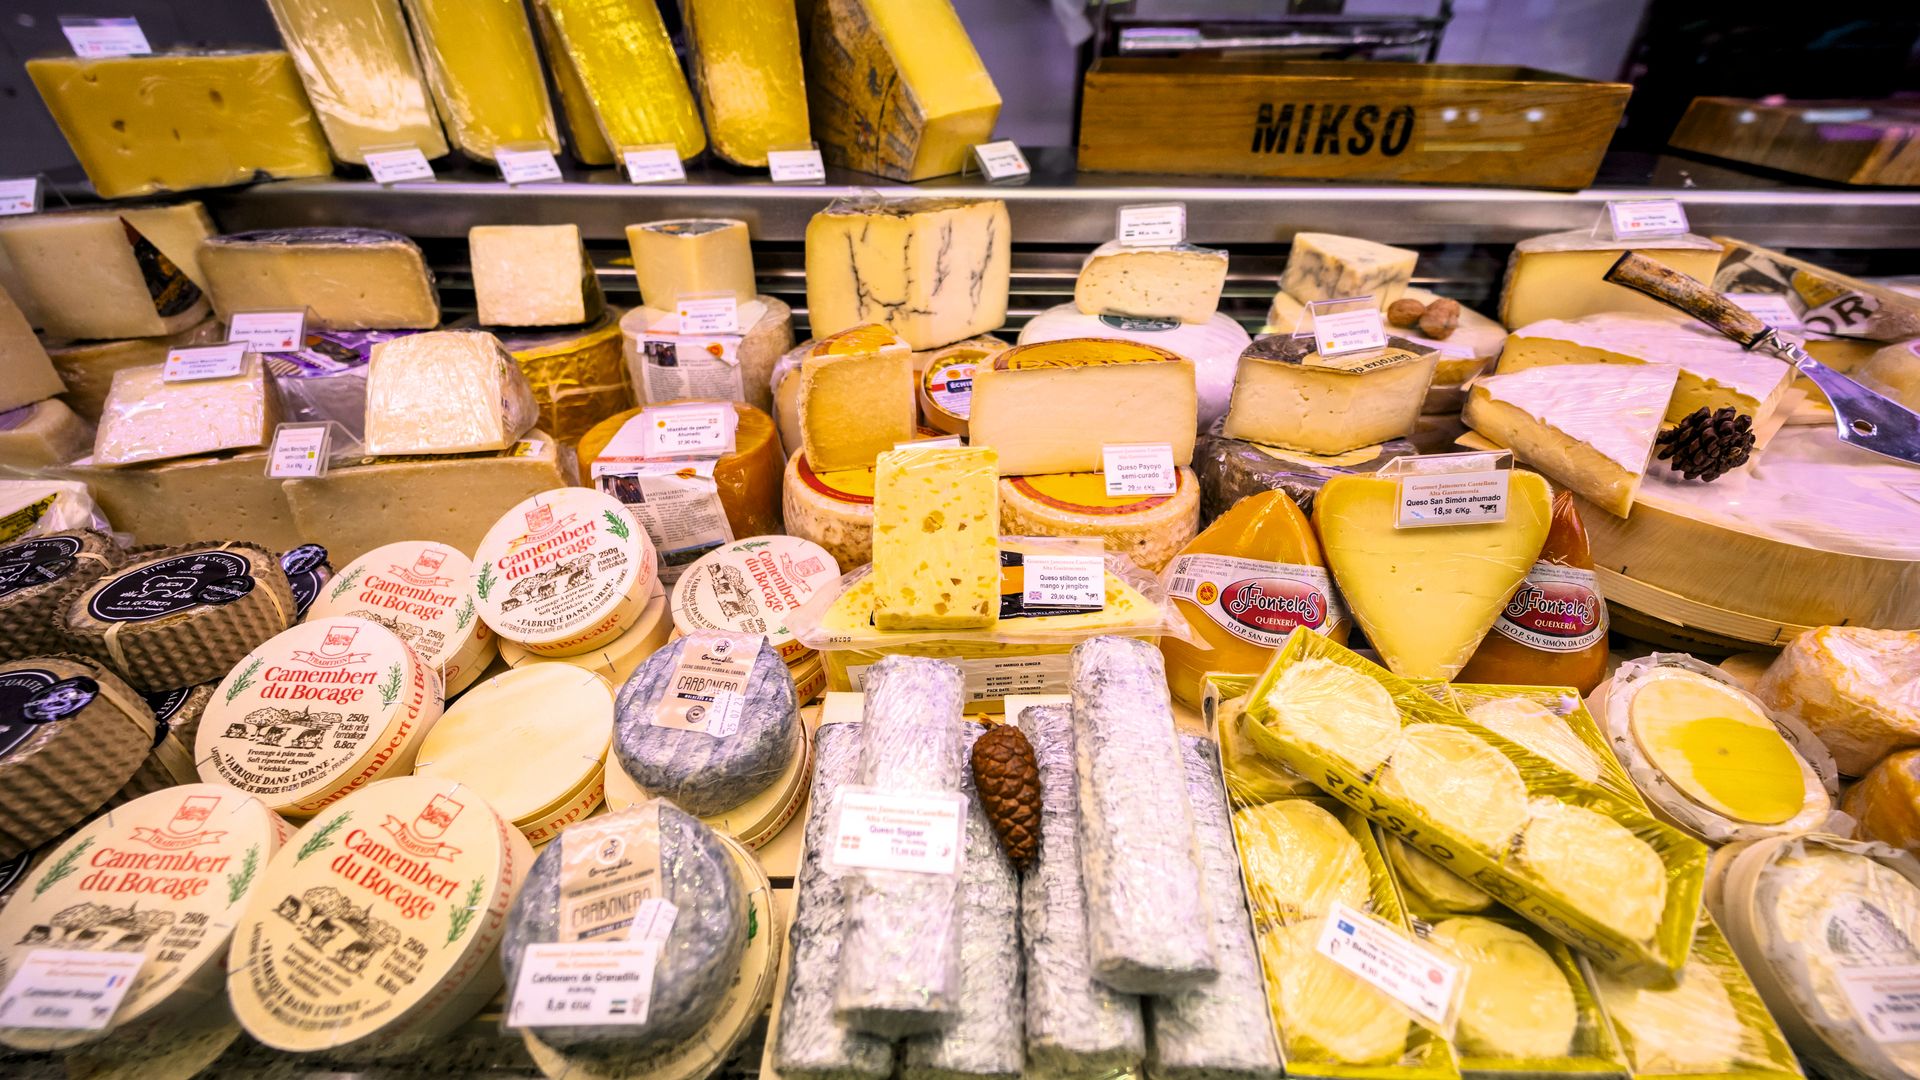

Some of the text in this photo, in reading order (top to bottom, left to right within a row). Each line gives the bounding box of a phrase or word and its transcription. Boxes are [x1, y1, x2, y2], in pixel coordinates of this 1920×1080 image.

[1252, 103, 1415, 157] MIKSO
[1445, 496, 1466, 504] Simón
[1468, 494, 1501, 502] ahumado
[528, 524, 562, 542] TRADITION
[498, 520, 597, 570] Camembert
[598, 547, 619, 558] 250g
[142, 560, 185, 574] FINCA
[506, 535, 597, 581] du Bocage
[402, 572, 435, 585] TRADITION
[745, 557, 784, 613] du Bocage
[758, 551, 801, 611] Camembert
[364, 575, 458, 608] Camembert
[360, 590, 444, 621] du Bocage
[521, 582, 612, 628] FABRIQUÉ DANS L'ORNE
[534, 598, 560, 612] Fromage
[558, 613, 620, 650] Bocage
[755, 617, 767, 634] 250g
[1255, 616, 1299, 628] QUEIXERÍA
[1534, 618, 1576, 630] QUEIXERÍA
[426, 630, 445, 640] 250g
[1227, 622, 1284, 644] D.O.P. SAN SIMÓ
[1502, 624, 1524, 639] D.O.P.
[1526, 634, 1541, 644] SAN
[1542, 638, 1567, 648] SIMÓN
[1578, 634, 1595, 646] COSTA
[308, 652, 349, 667] TRADITION
[702, 654, 734, 664] Granadilla
[264, 666, 378, 685] Camembert
[677, 676, 738, 692] CARBONERO
[260, 683, 364, 705] du Bocage
[346, 713, 369, 724] 250g
[282, 750, 298, 759] pâte
[300, 692, 424, 812] Camembert du
[334, 740, 356, 750] 8.8oz
[247, 756, 310, 766] Soft ripened cheese
[258, 764, 292, 772] Weichkäse
[332, 751, 355, 770] FRANCE
[226, 756, 330, 785] FABRIQUÉ DANS L'ORNE
[152, 834, 200, 848] TRADITION
[399, 826, 438, 857] TRADITION
[90, 848, 232, 874] Camembert
[344, 829, 460, 900] Camembert
[80, 870, 209, 901] du Bocage
[330, 854, 436, 920] du Bocage
[403, 936, 428, 960] 250g
